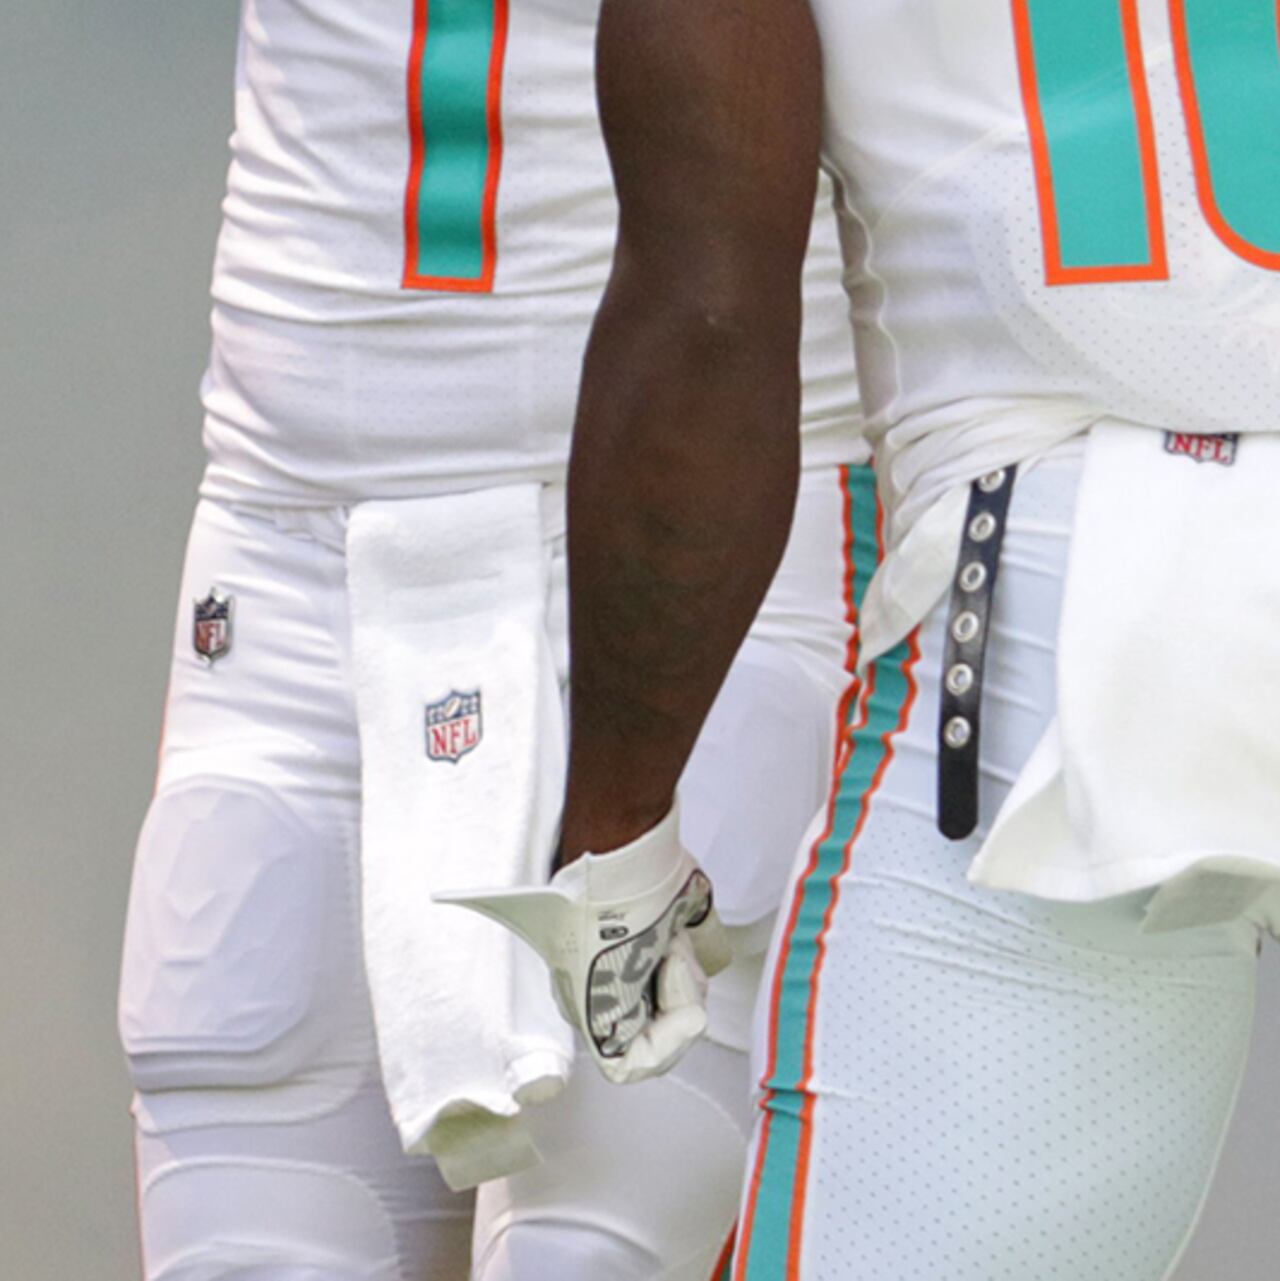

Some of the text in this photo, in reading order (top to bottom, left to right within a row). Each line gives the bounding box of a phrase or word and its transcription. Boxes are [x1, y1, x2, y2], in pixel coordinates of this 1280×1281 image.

[1172, 431, 1231, 465] NFL
[194, 621, 226, 654] NFL
[429, 717, 478, 756] NFL
